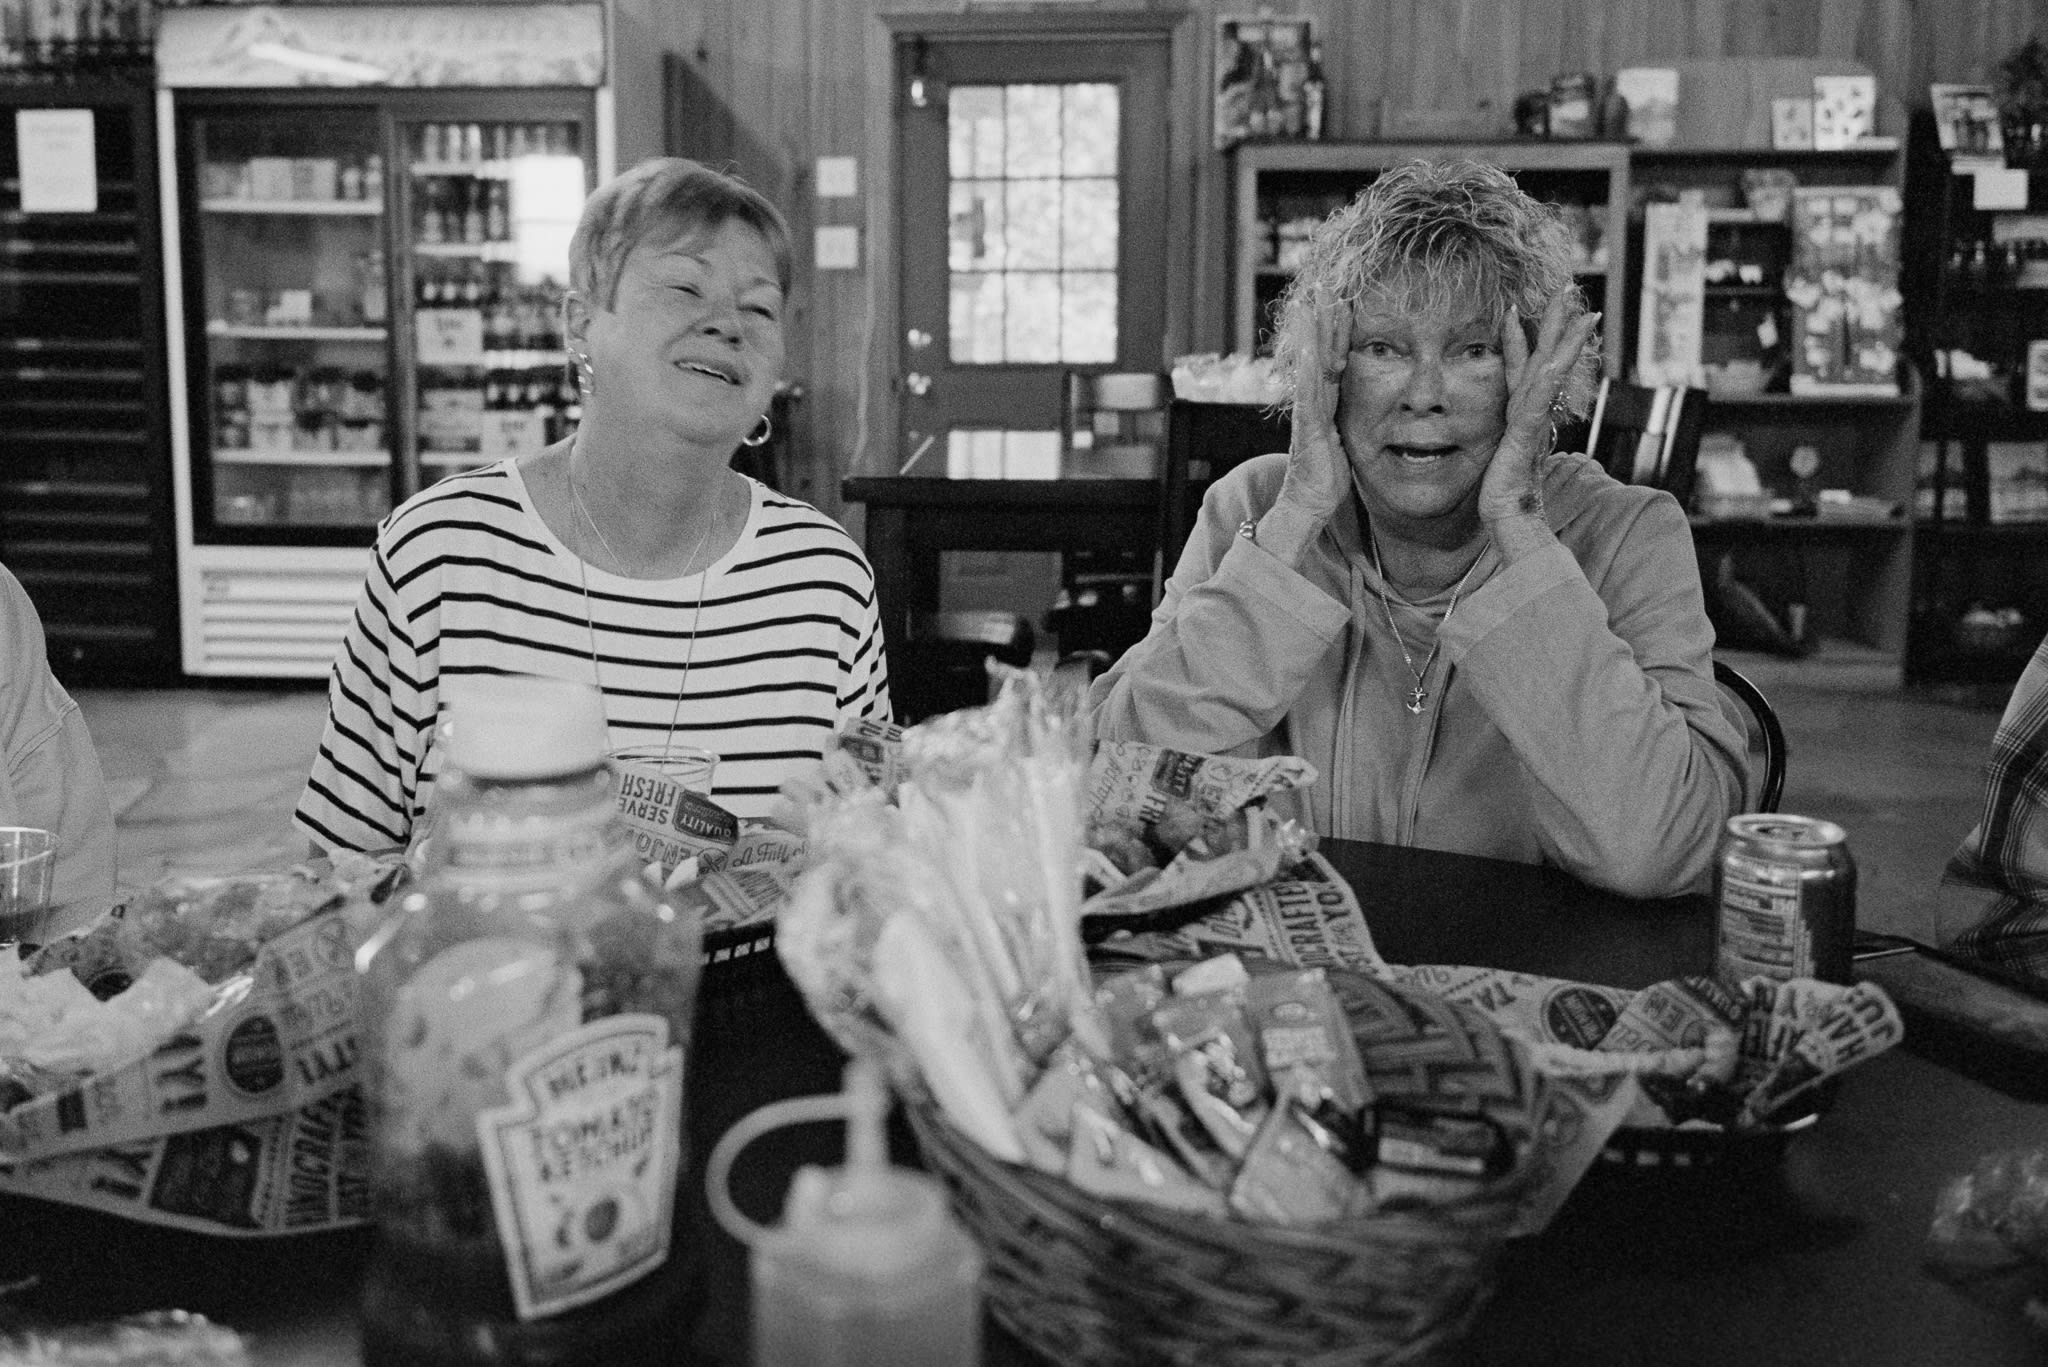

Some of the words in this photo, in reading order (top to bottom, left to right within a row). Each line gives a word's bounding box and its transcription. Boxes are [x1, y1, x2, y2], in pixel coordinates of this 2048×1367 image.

[619, 773, 677, 807] FRESH
[618, 797, 669, 825] SERVE
[680, 813, 732, 838] QUALITY
[626, 829, 692, 867] ENJO
